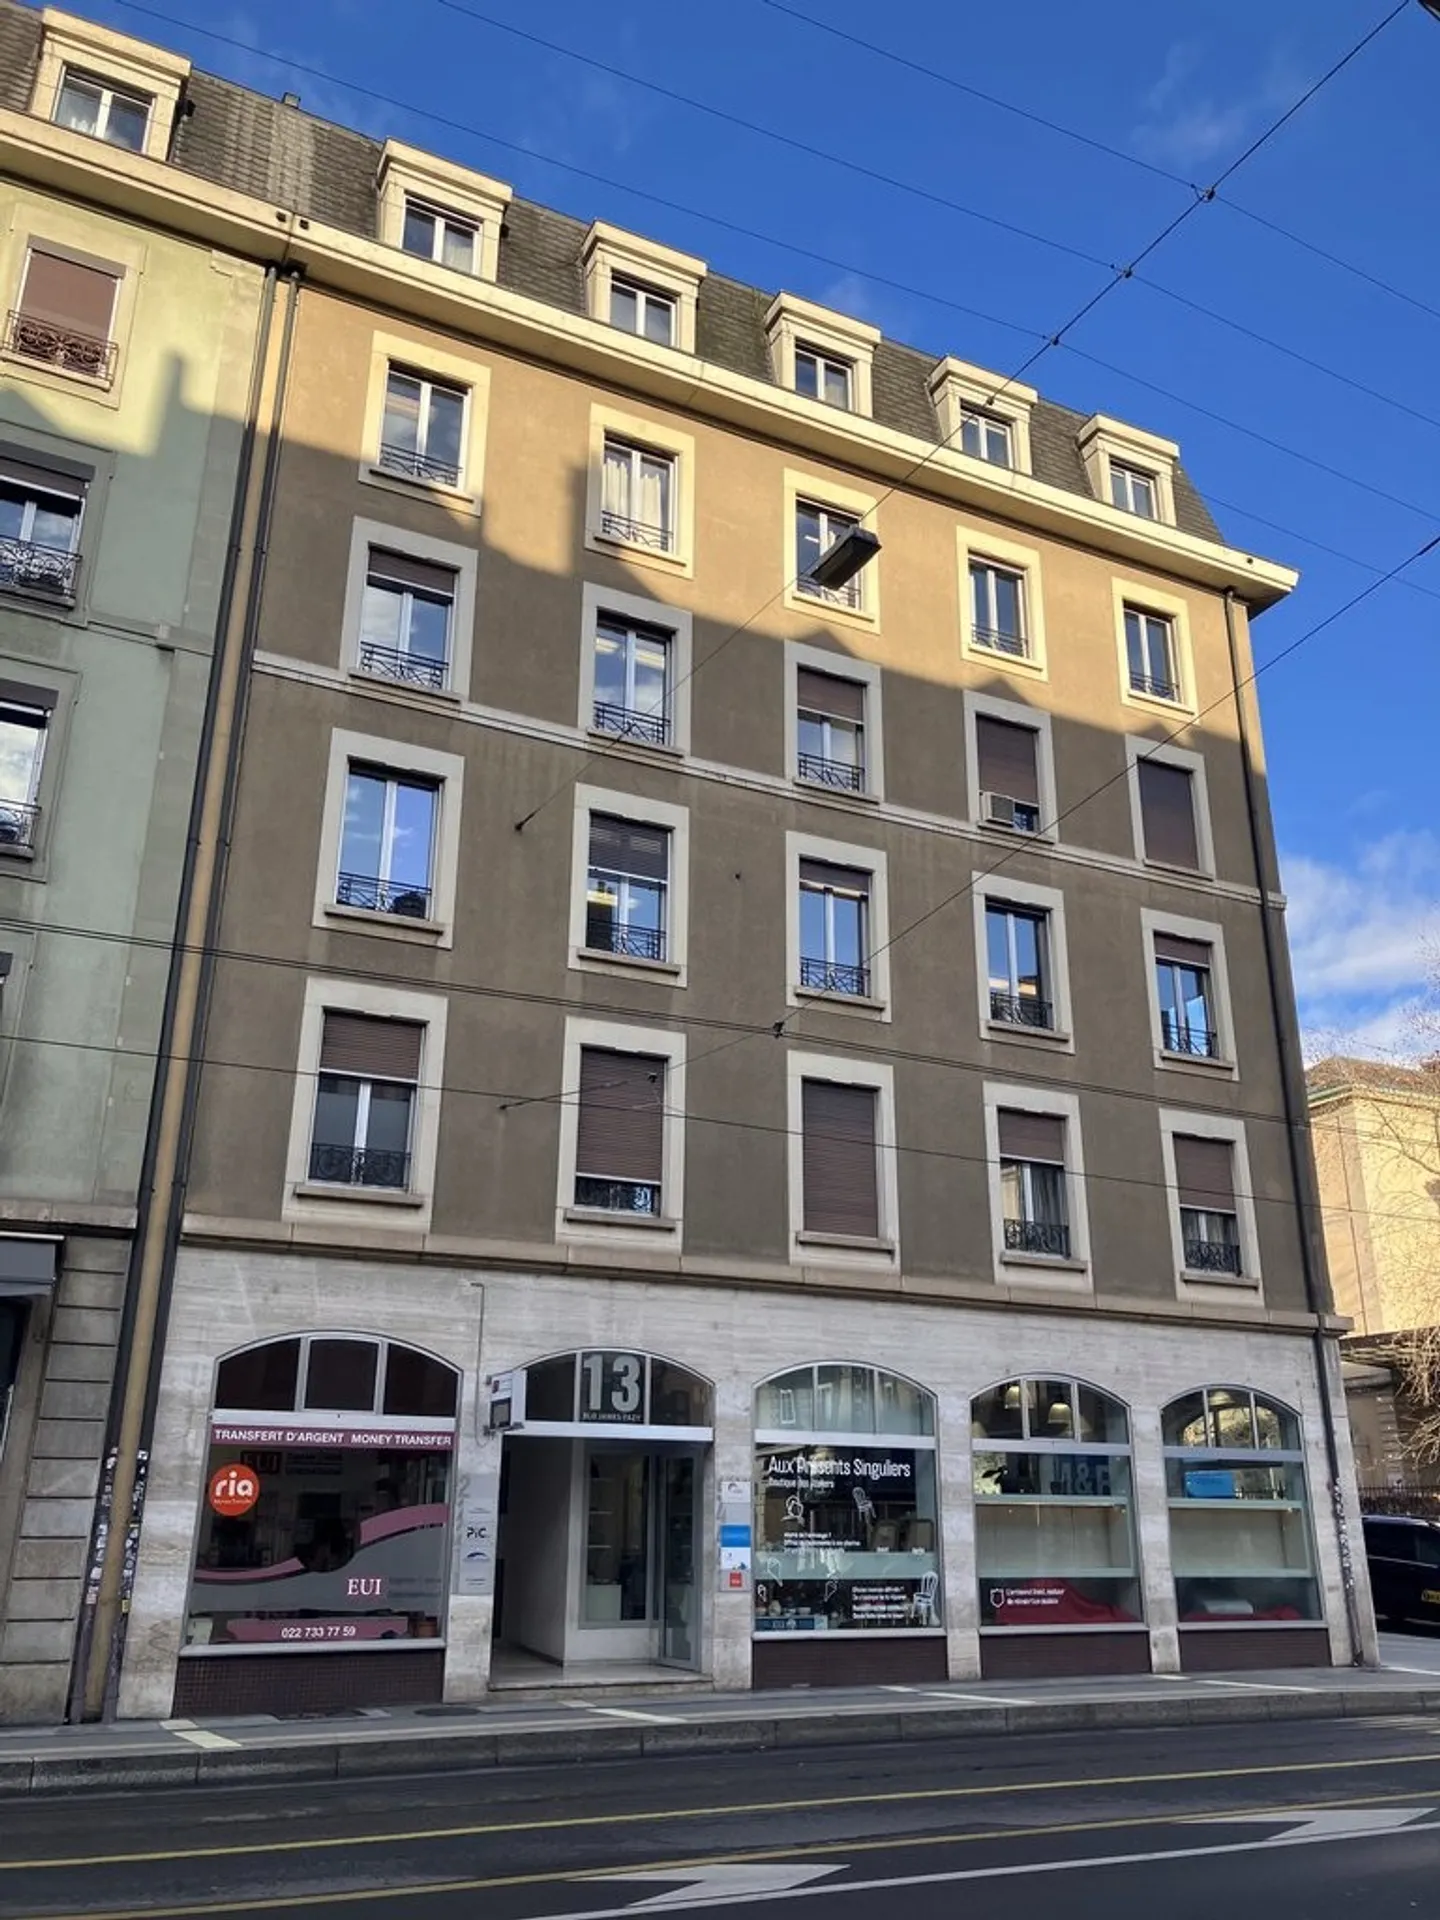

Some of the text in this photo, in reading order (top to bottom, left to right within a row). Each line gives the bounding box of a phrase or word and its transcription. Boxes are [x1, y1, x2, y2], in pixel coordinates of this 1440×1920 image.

[583, 1354, 641, 1412] 13
[215, 1429, 451, 1446] TRANSFERT D'ARGENT MONEY TRANSFER
[768, 1455, 794, 1474] Aux
[853, 1458, 911, 1480] Singuliers
[215, 1471, 253, 1497] ria
[347, 1578, 382, 1595] EUI
[281, 1626, 356, 1639] 022 733 77 59
